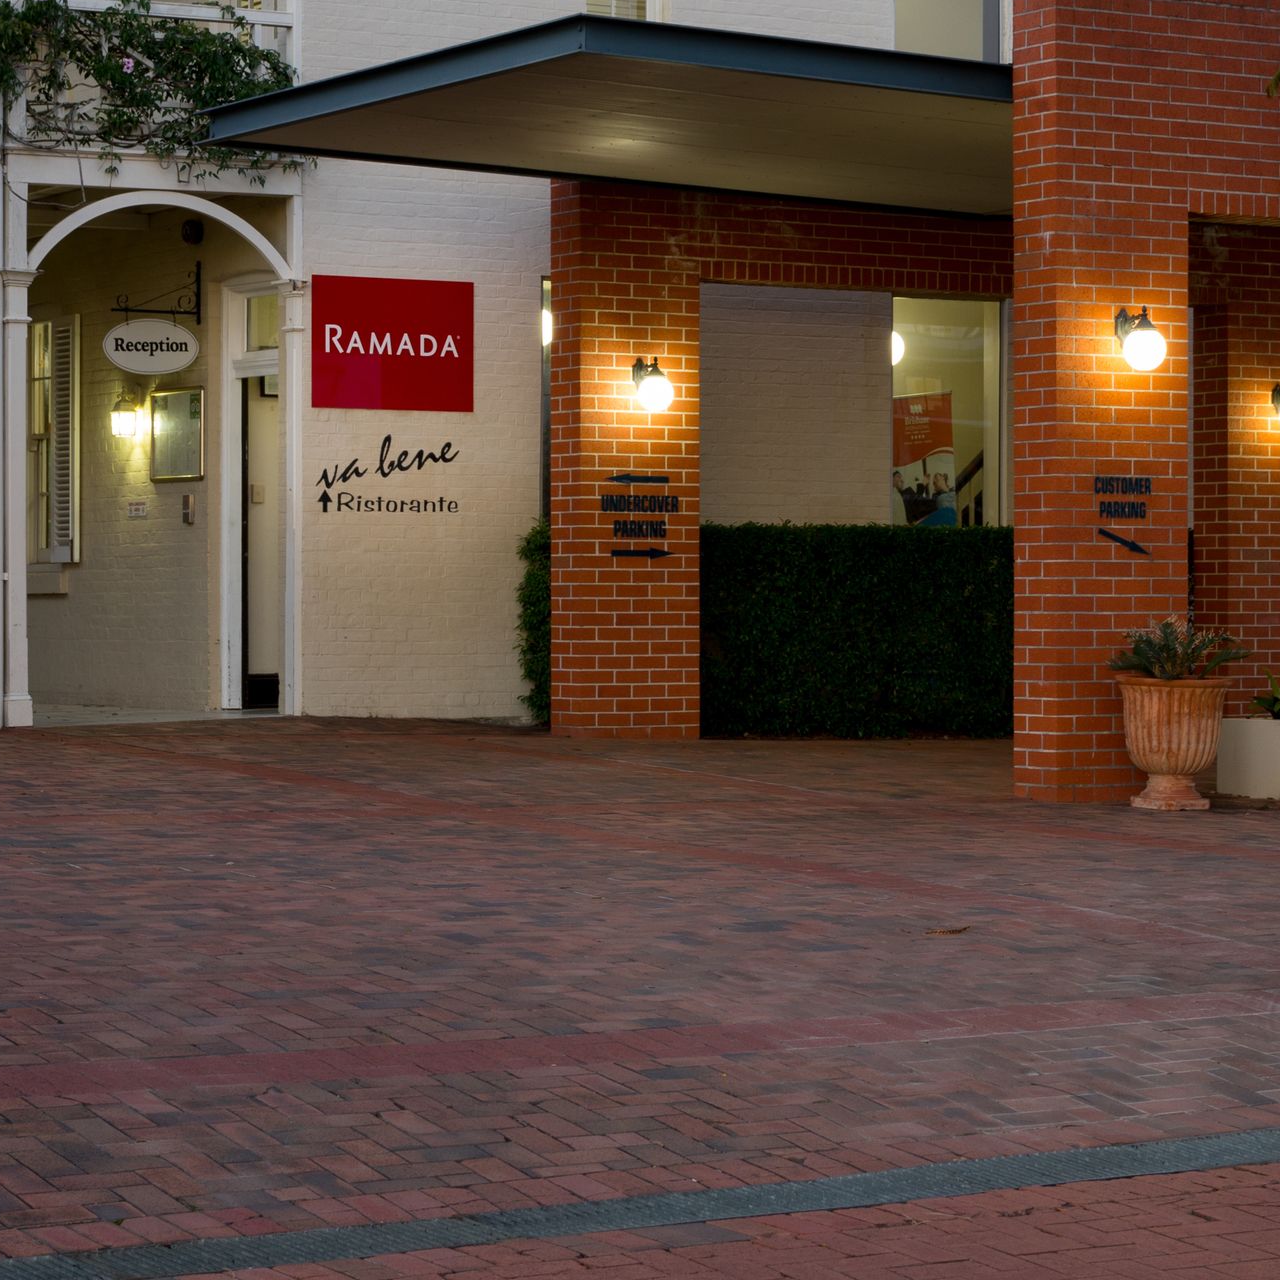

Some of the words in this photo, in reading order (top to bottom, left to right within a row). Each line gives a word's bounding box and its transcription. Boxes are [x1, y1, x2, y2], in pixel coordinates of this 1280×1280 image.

[113, 337, 189, 356] Reception
[325, 323, 459, 358] RAMADA
[315, 458, 368, 489] va
[375, 433, 460, 478] bene
[1094, 476, 1152, 495] CUSTOMER
[336, 491, 460, 513] Ristorante
[601, 494, 679, 513] UNDERCOVER
[1099, 501, 1147, 519] PARKING
[613, 520, 667, 538] PARKING
